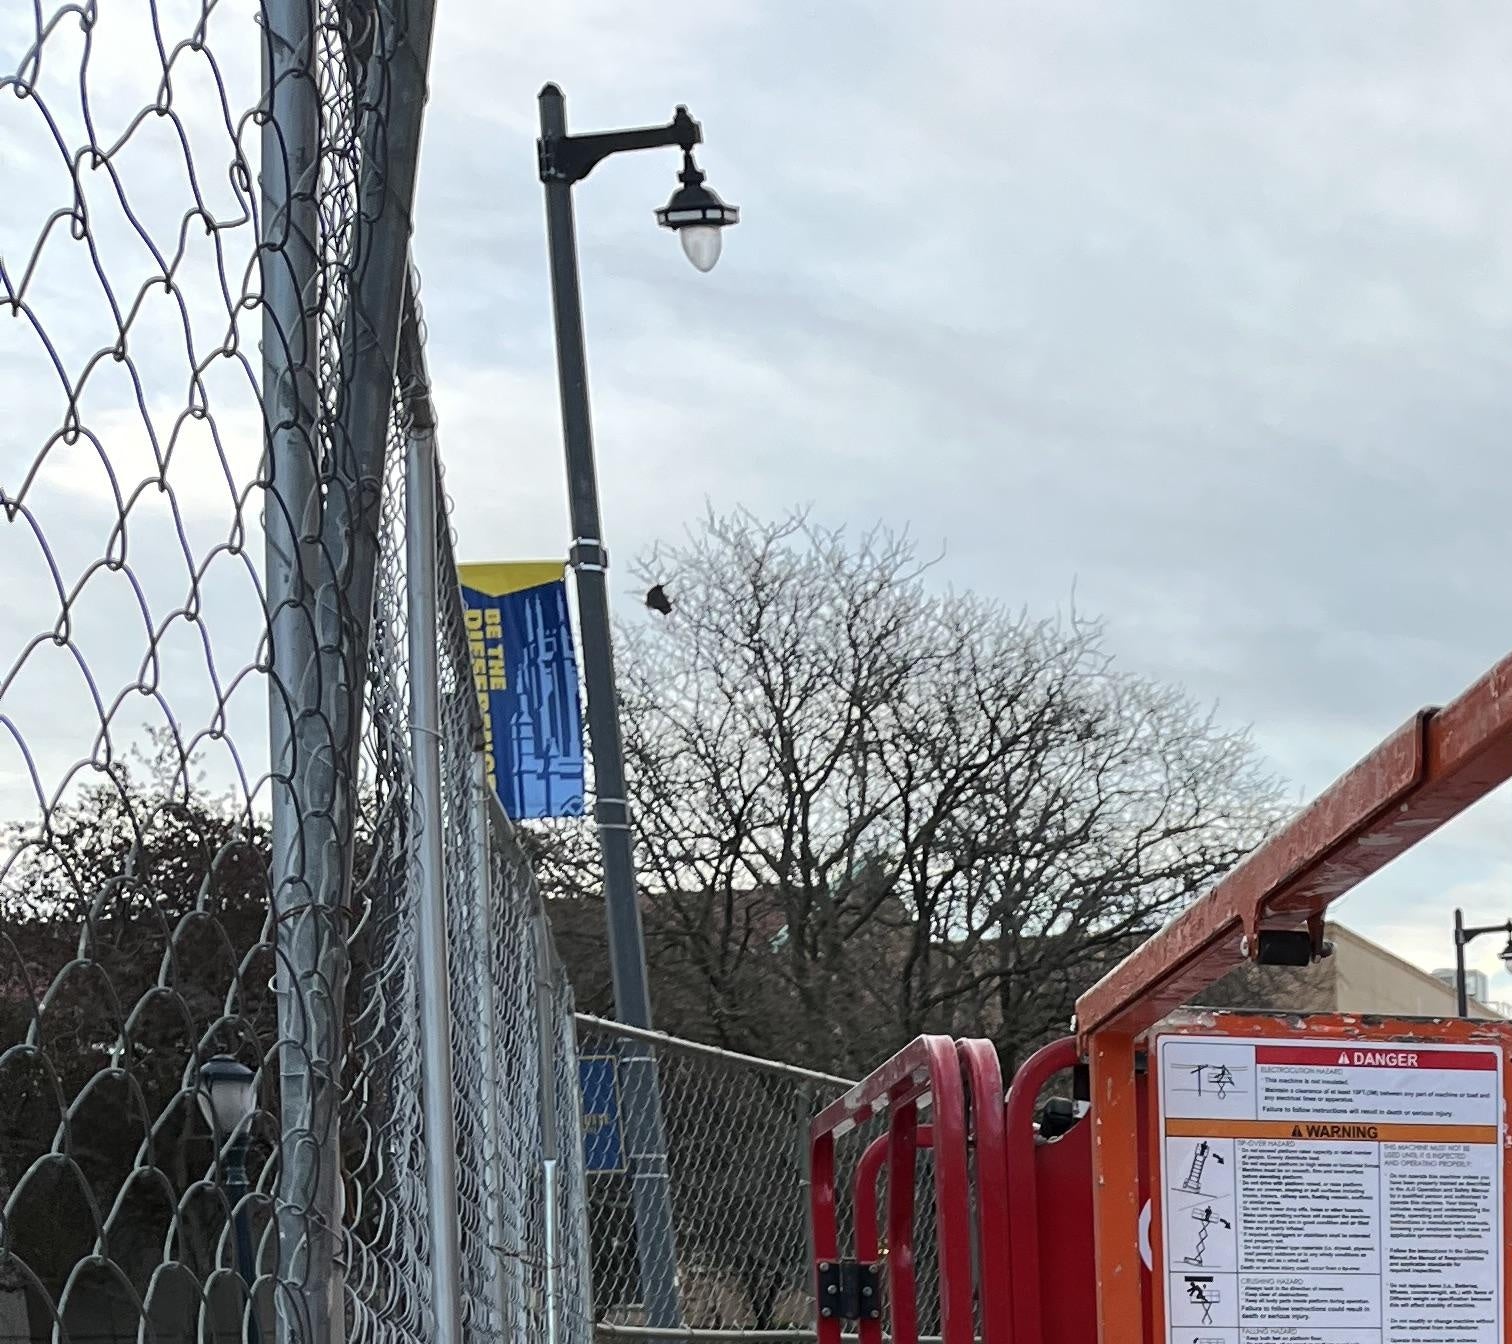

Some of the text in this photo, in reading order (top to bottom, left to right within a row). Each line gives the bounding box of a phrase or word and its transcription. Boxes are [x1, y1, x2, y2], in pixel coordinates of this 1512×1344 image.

[484, 608, 507, 690] BE THE
[1353, 1052, 1418, 1067] DANGER
[1305, 1125, 1378, 1139] WARNING
